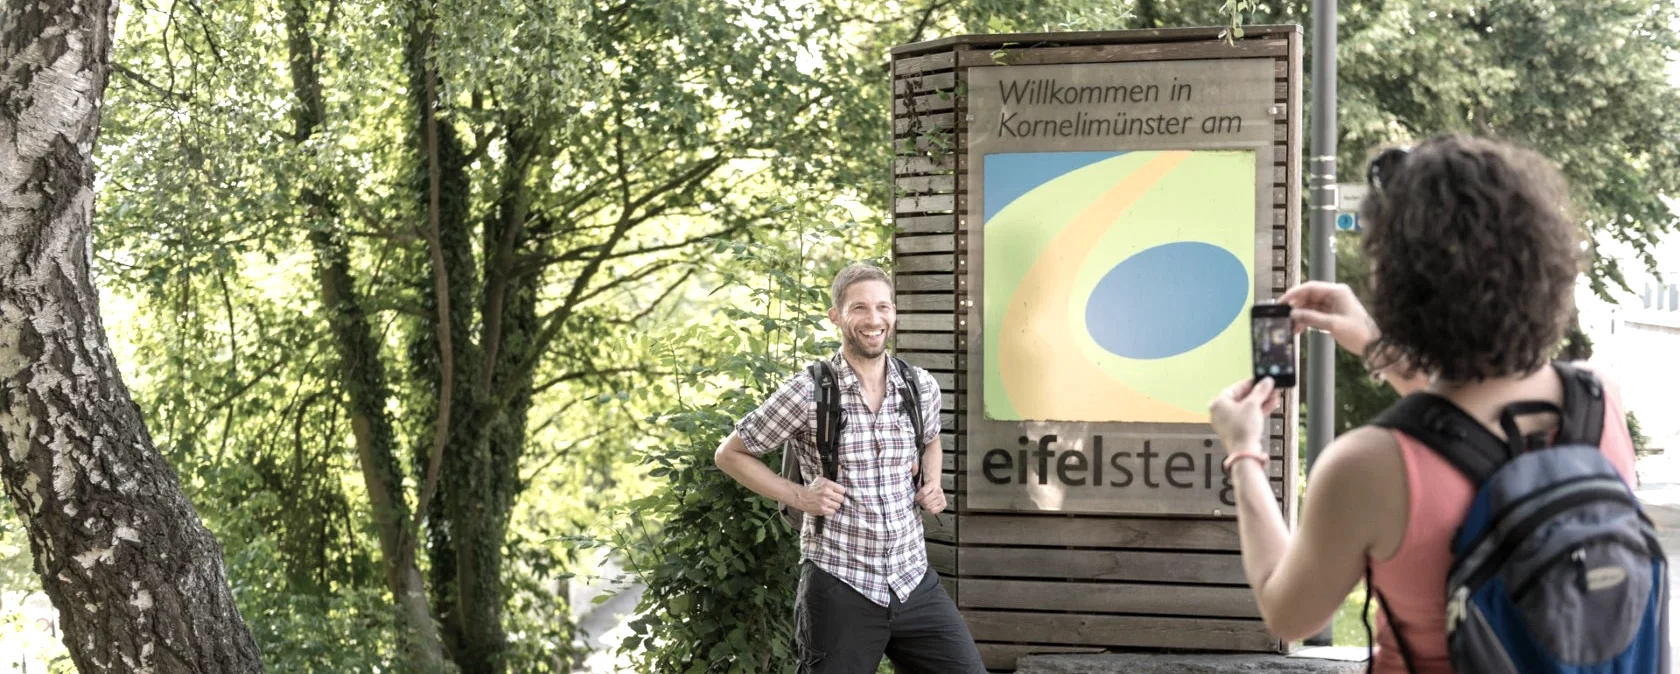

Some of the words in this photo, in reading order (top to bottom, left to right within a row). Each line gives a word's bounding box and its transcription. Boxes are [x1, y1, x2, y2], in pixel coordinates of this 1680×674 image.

[999, 79, 1158, 105] Willkommen
[1170, 77, 1192, 101] in
[998, 112, 1193, 138] Kornelimünster
[1202, 115, 1242, 134] am
